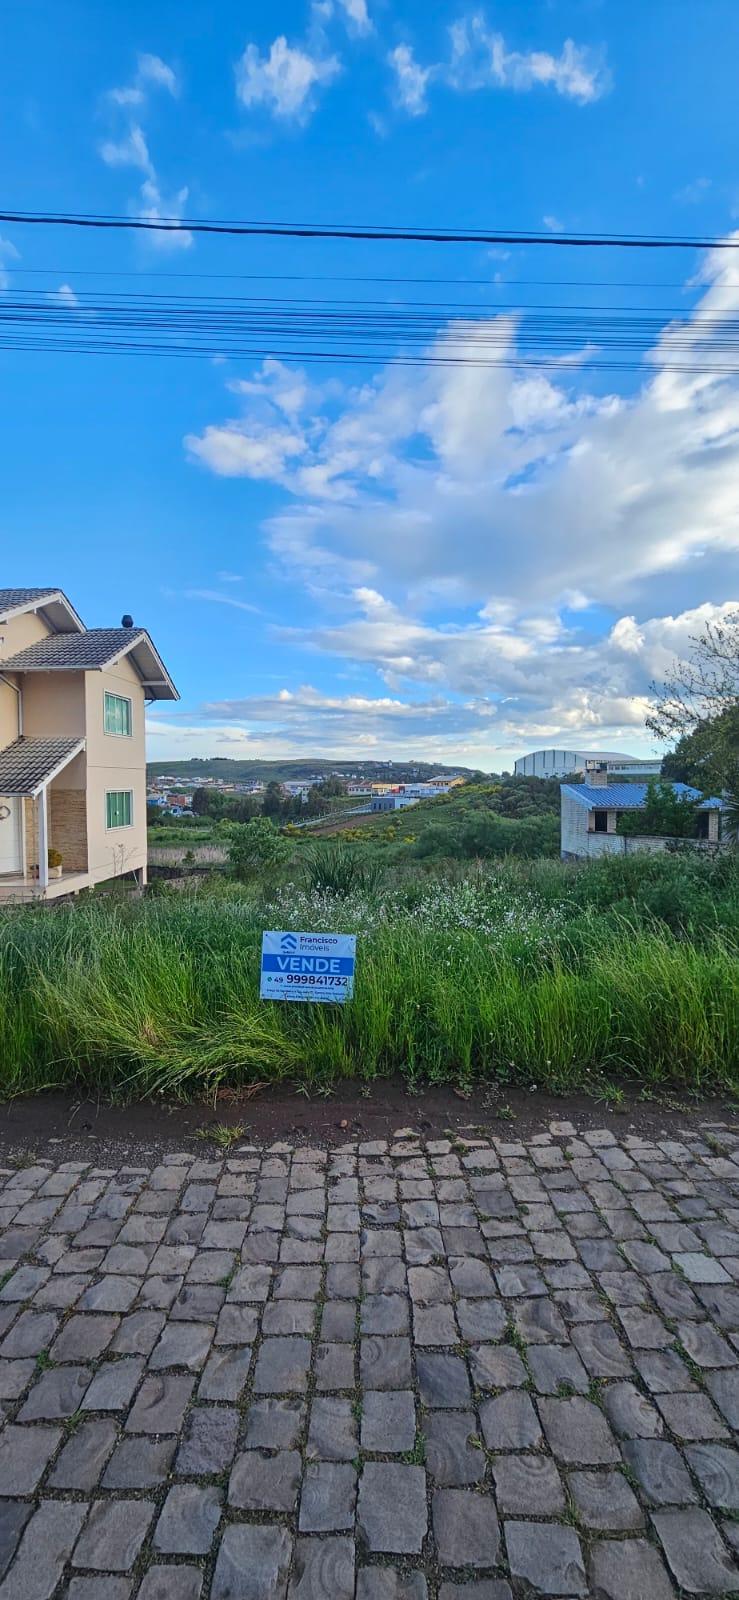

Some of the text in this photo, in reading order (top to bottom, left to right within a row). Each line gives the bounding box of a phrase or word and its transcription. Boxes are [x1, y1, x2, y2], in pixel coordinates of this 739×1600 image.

[300, 936, 338, 944] Francisco
[277, 956, 341, 973] VENDE
[286, 974, 348, 986] 999841732
